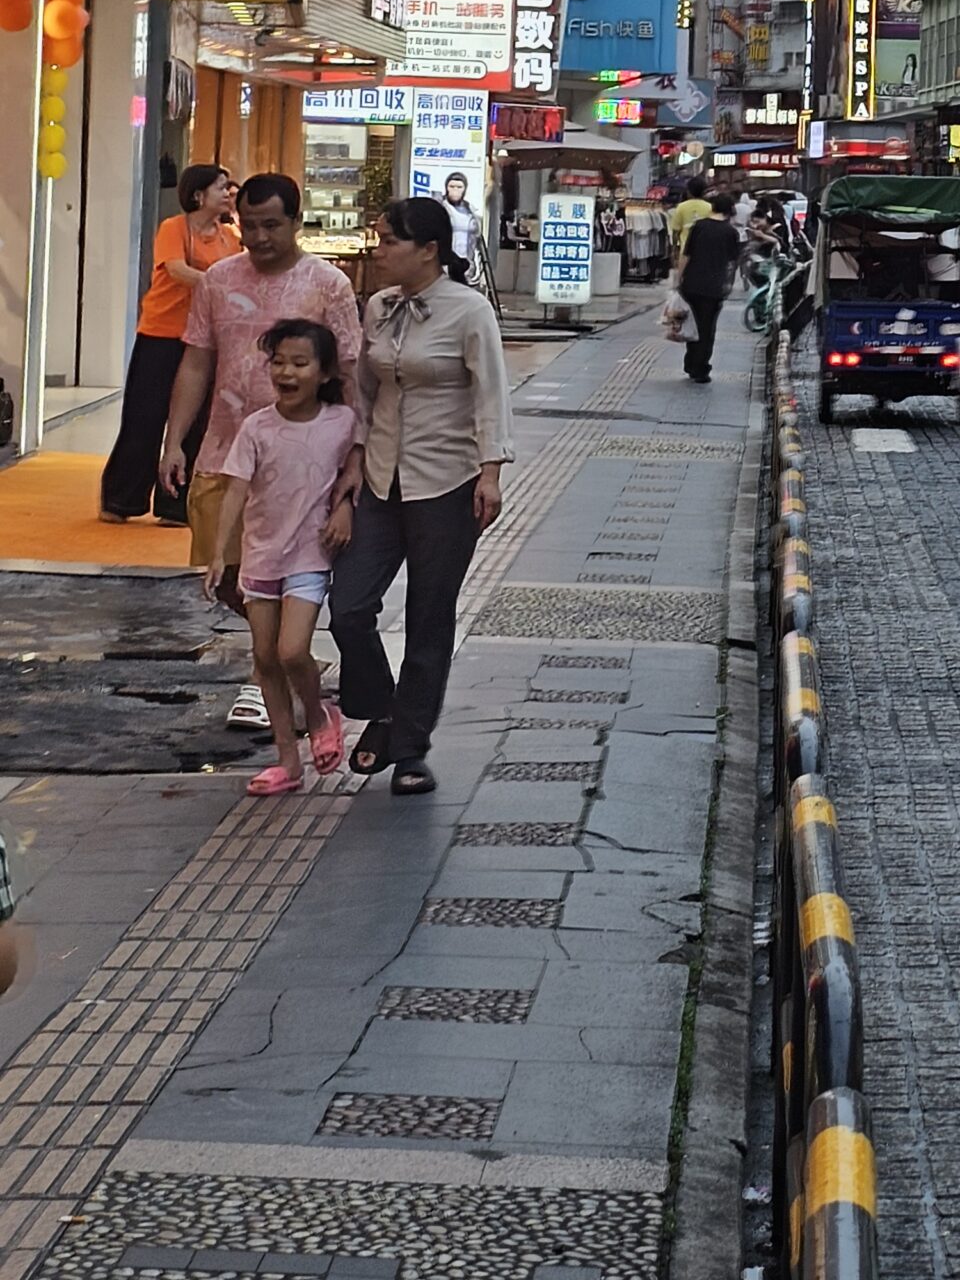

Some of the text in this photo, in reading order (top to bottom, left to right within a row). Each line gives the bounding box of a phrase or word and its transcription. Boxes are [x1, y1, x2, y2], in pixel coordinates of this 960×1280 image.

[418, 94, 484, 111] 高价回收
[417, 113, 483, 131] 抵押寄售
[544, 224, 589, 239] 高价回收
